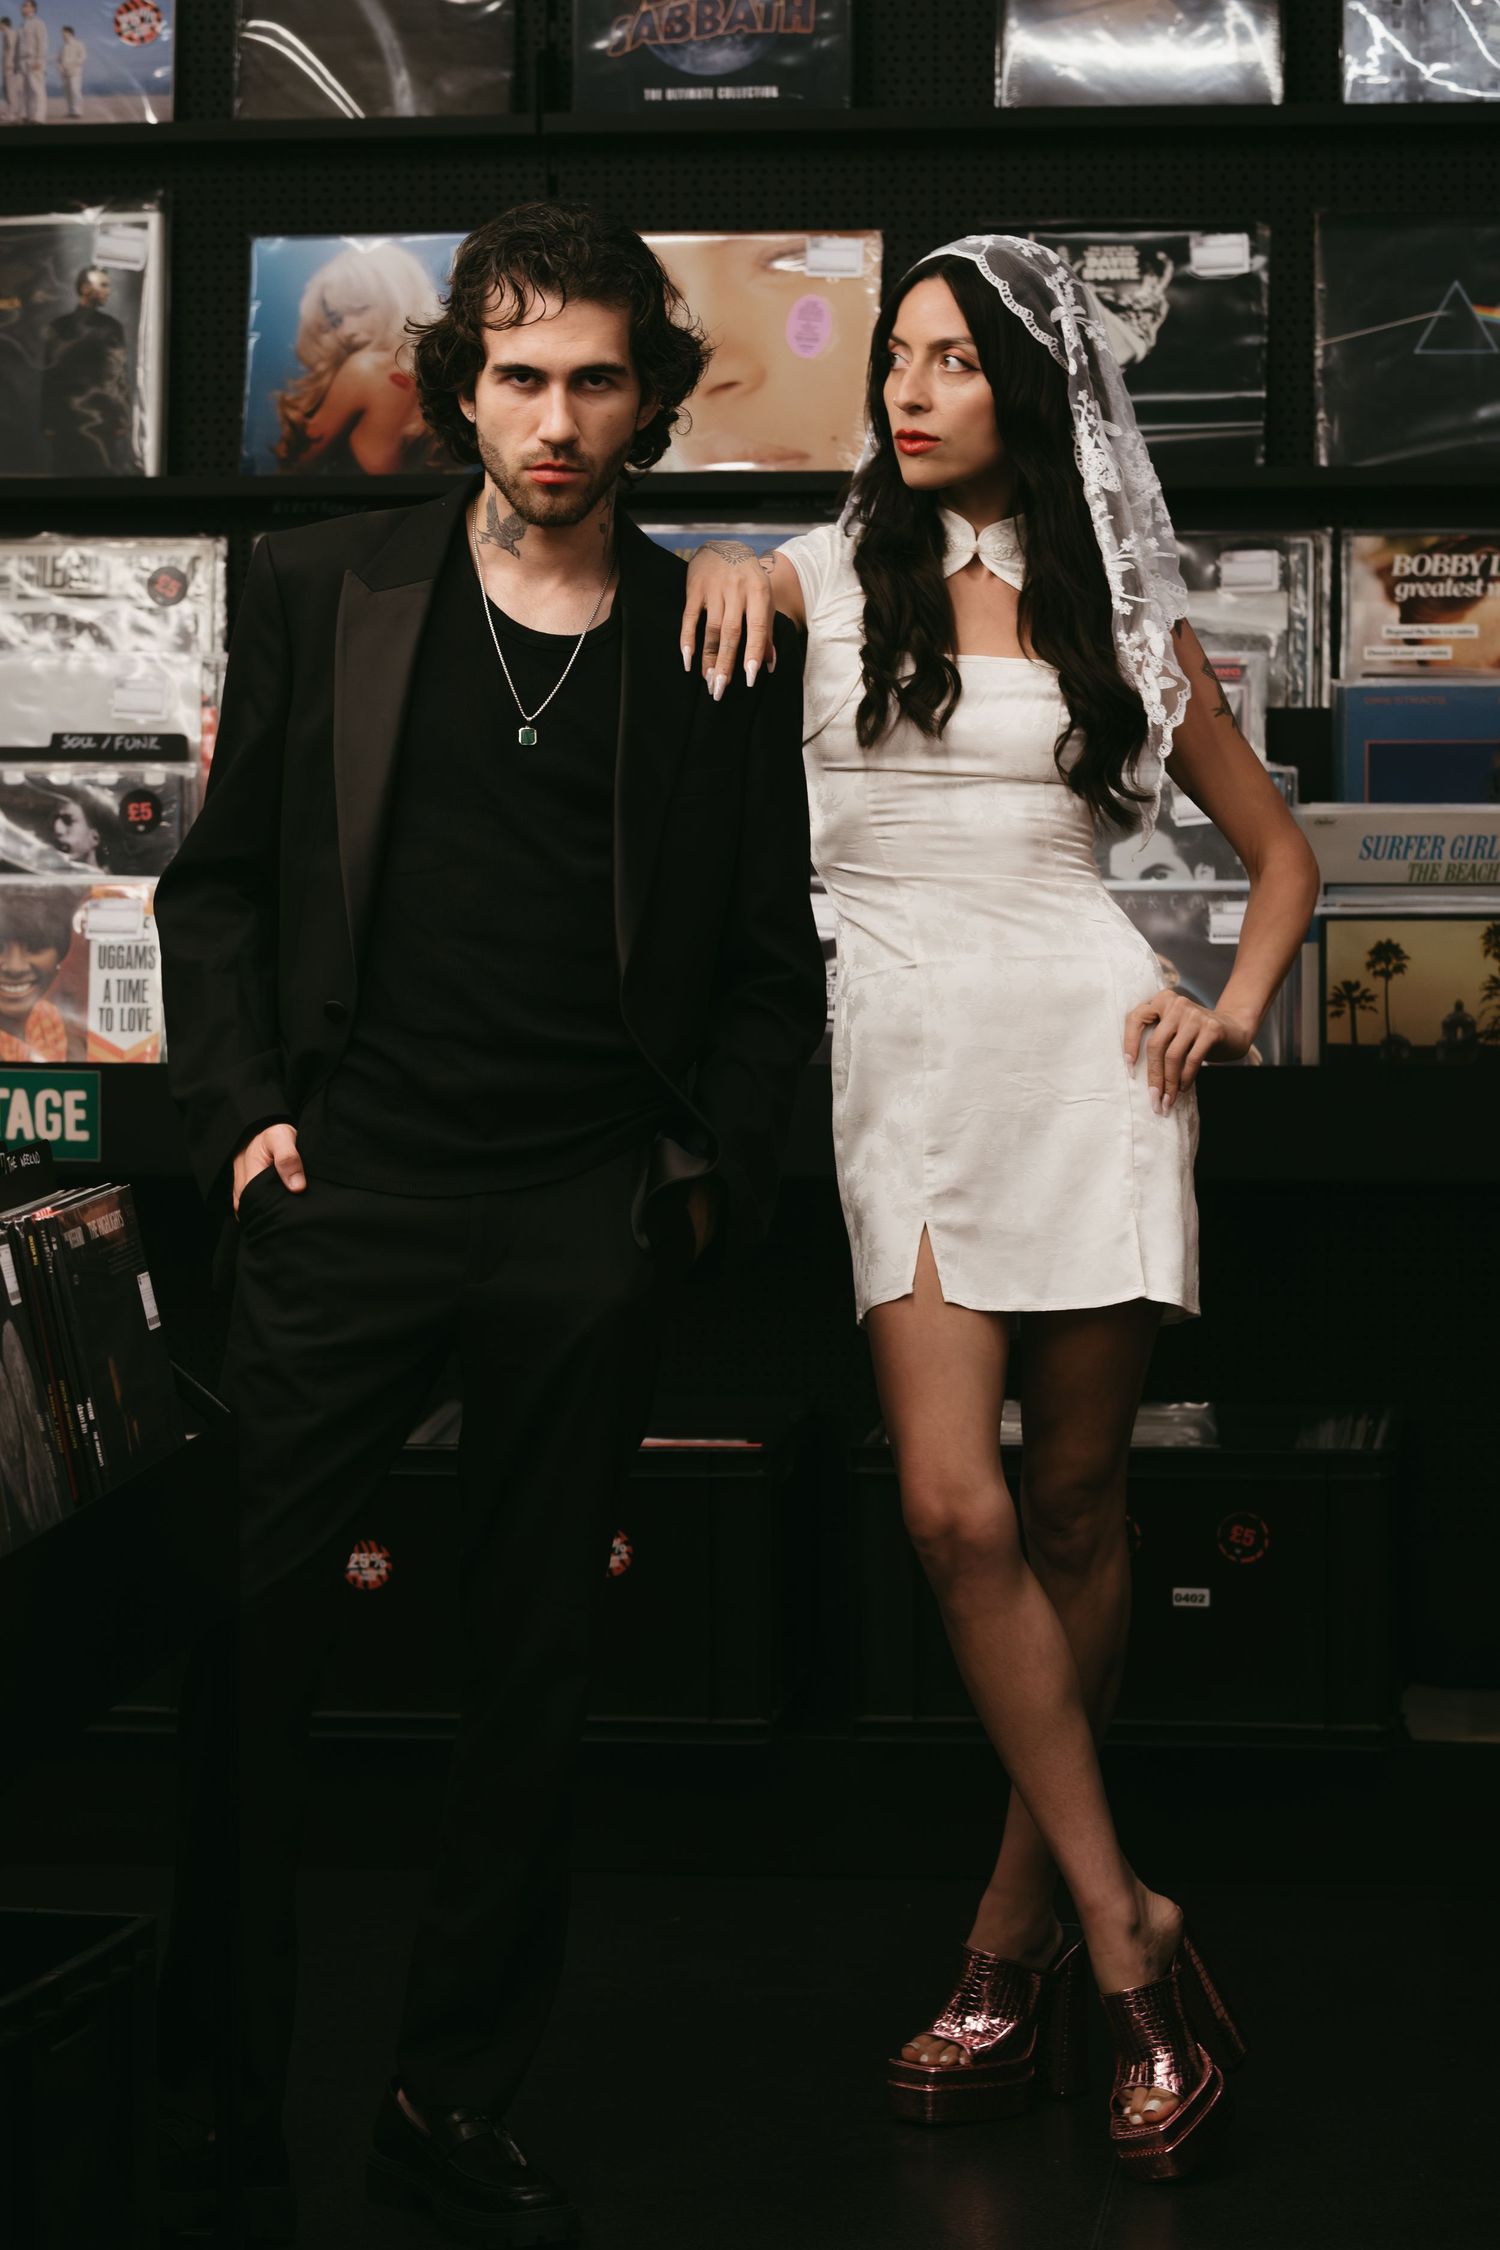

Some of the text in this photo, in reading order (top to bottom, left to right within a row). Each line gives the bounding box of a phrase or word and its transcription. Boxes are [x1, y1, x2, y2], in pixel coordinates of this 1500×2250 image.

[717, 86, 779, 98] COLLECTION
[1086, 257, 1139, 269] DAVID
[1391, 553, 1486, 577] BOBBY
[1394, 578, 1483, 602] greatest
[114, 736, 162, 751] FUNK
[127, 802, 153, 822] £5
[1358, 834, 1500, 861] SURFER GIRL
[1407, 862, 1500, 883] THE BEACH
[98, 945, 156, 970] UGGAMS
[103, 979, 149, 1004] A TIME
[98, 1008, 152, 1032] TO LOVE
[1229, 1524, 1257, 1547] £5
[348, 1553, 387, 1569] 25%
[1174, 1592, 1206, 1604] 0402
